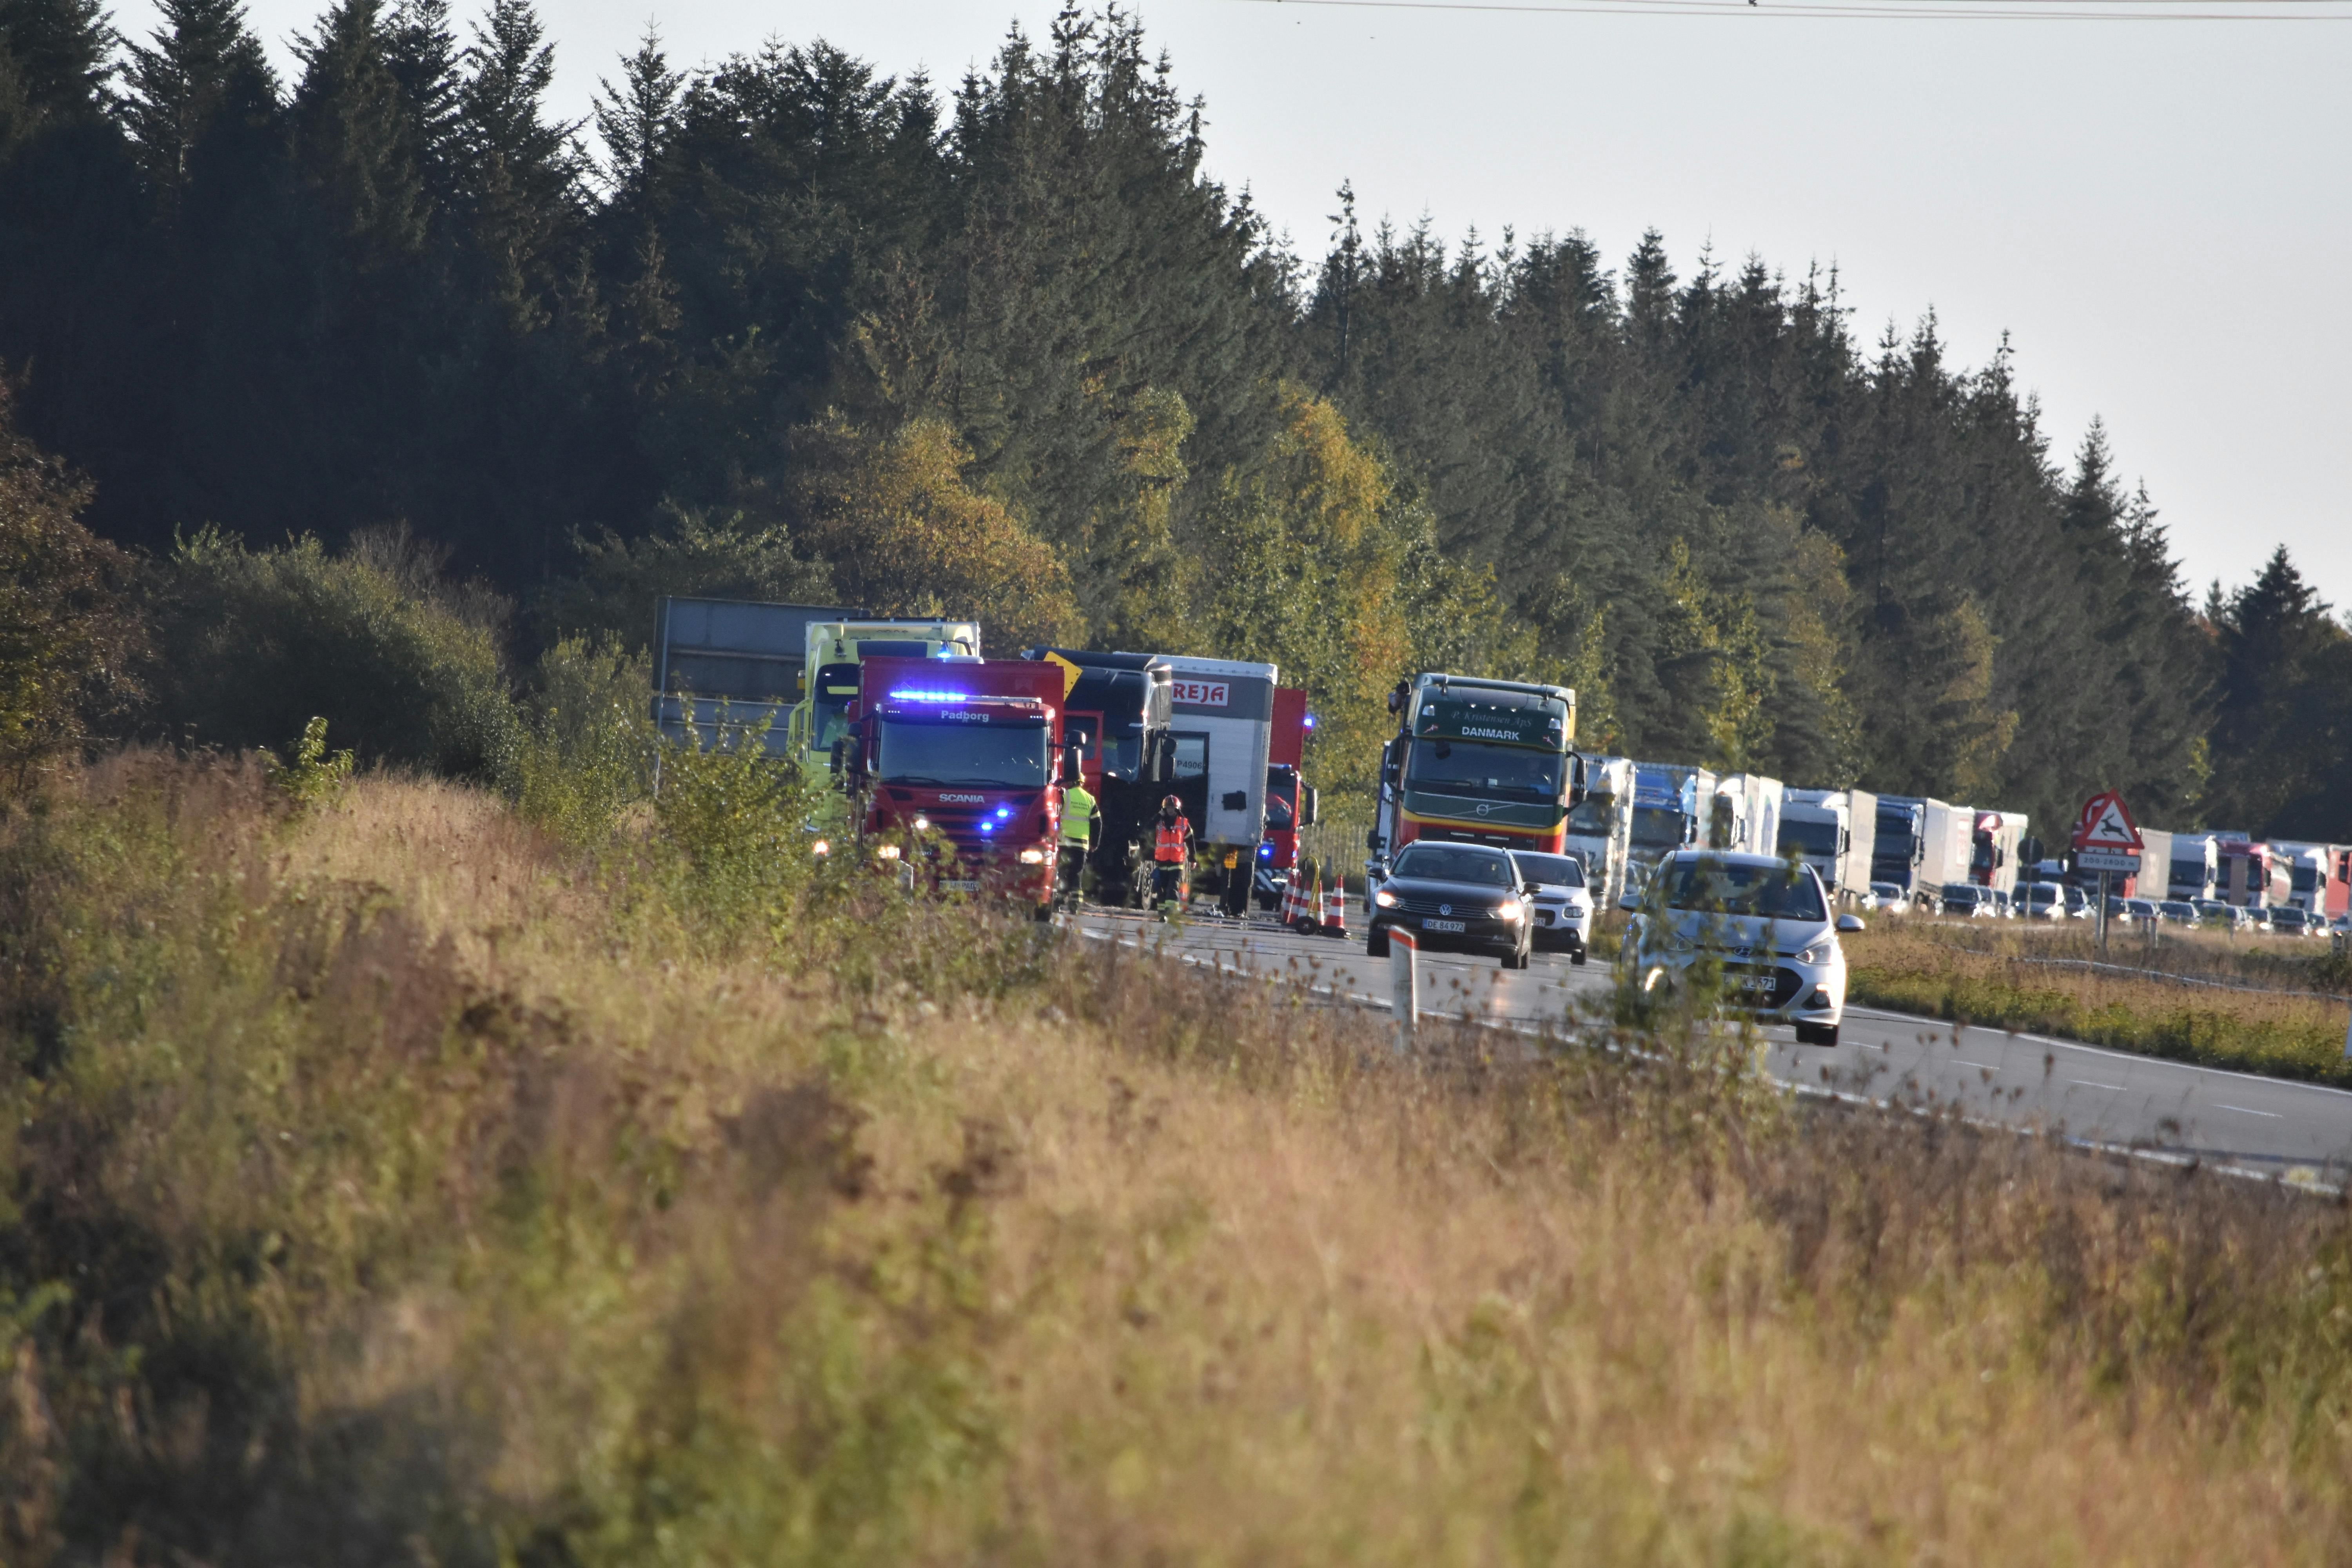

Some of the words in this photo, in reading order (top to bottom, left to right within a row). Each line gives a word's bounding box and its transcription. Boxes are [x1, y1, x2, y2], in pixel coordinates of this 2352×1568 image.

[941, 710, 989, 722] Padborg
[1464, 711, 1510, 724] Kristensen
[1511, 717, 1533, 728] ApS
[1462, 726, 1519, 740] DANMARK
[1177, 760, 1202, 769] P4906
[939, 793, 985, 803] SCANIA
[1450, 923, 1464, 931] 972
